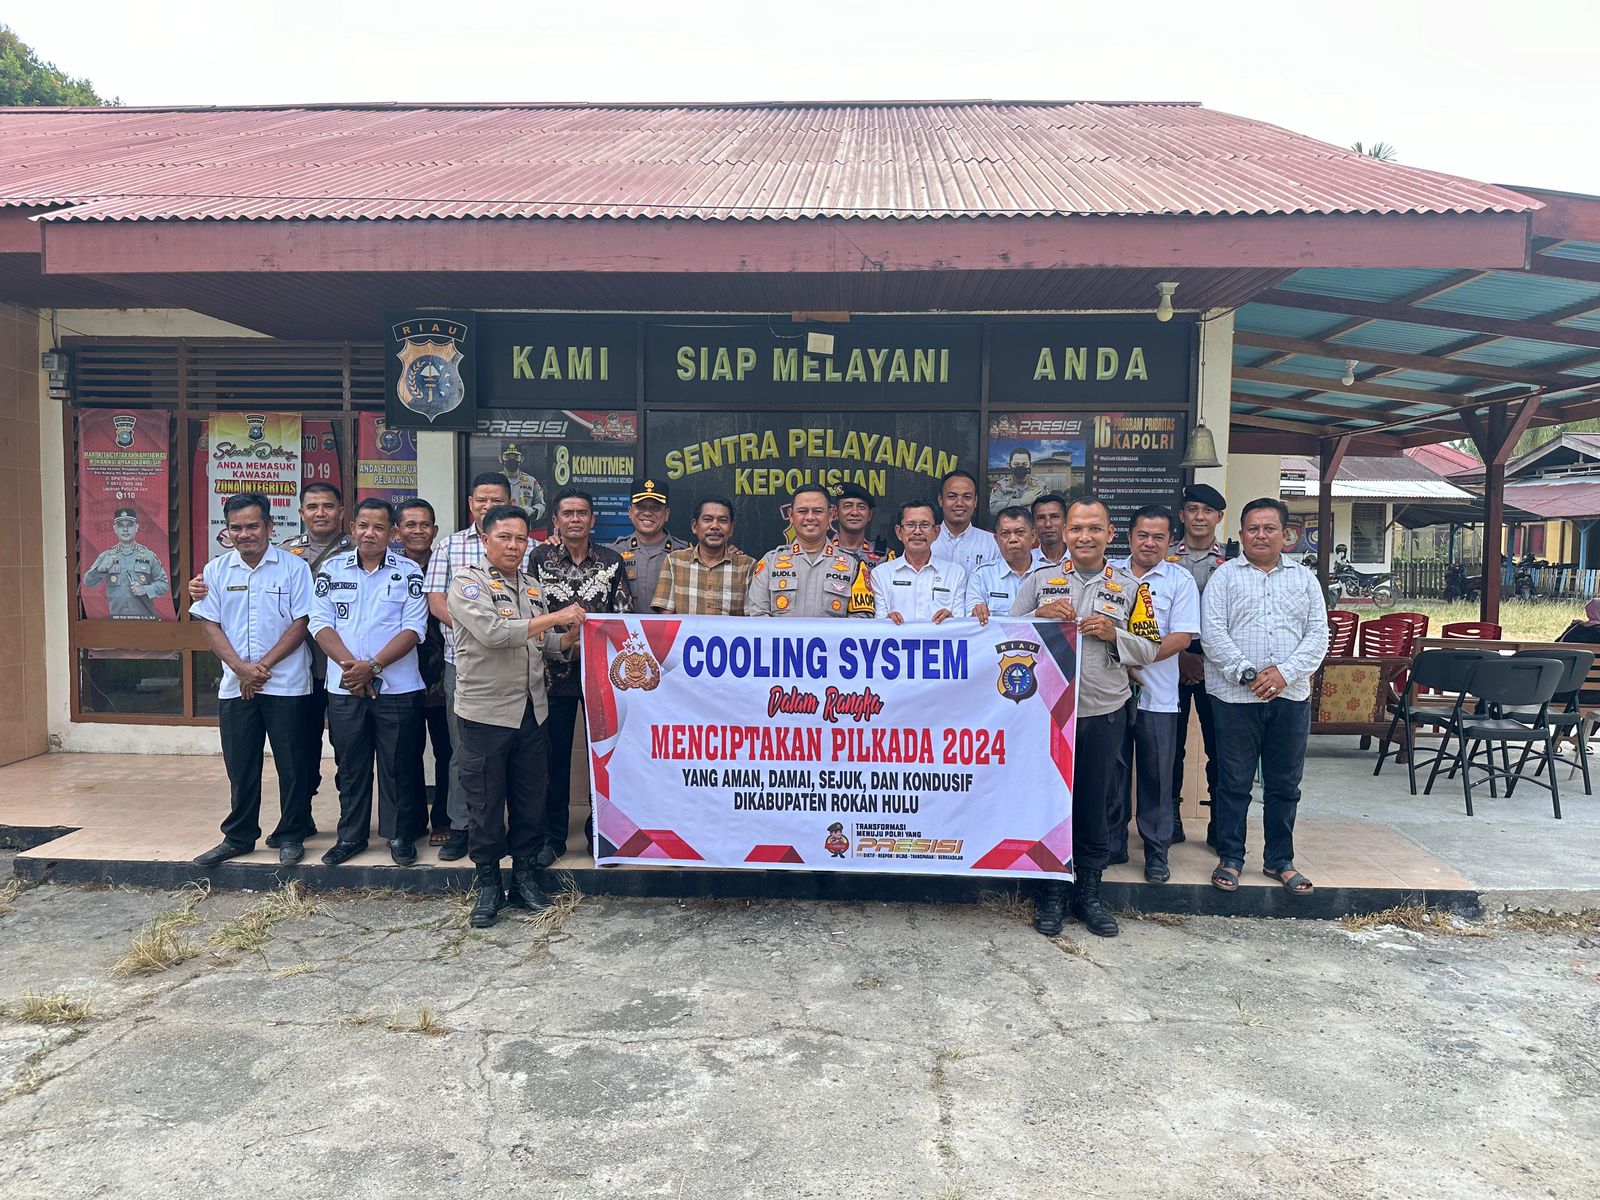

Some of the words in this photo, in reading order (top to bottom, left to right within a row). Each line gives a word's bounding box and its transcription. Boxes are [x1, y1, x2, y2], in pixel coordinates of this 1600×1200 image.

[402, 323, 457, 335] RIAU
[512, 345, 609, 380] KAMI
[676, 346, 757, 381] SIAP
[773, 347, 949, 383] MELAYANI
[1033, 347, 1148, 381] ANDA
[477, 420, 568, 433] PRESISI
[1019, 420, 1082, 431] PRESISI
[1093, 415, 1111, 448] 16
[1113, 418, 1143, 431] PROGRAM
[1144, 418, 1176, 431] PRIORITAS
[1113, 433, 1174, 449] KAPOLRI
[664, 430, 780, 481] SENTRA
[788, 428, 958, 480] PELAYANAN
[246, 462, 296, 471] MEMASUKI
[318, 463, 330, 479] 19
[360, 464, 378, 473] ANDA
[381, 464, 401, 474] TIDAK
[404, 464, 417, 474] PUA
[555, 445, 570, 486] 8
[572, 456, 634, 475] KOMITMEN
[215, 479, 241, 494] ZONA
[241, 480, 297, 496] INTEGRITAS
[374, 475, 415, 485] PELAYANAN
[272, 498, 290, 507] HULU
[826, 573, 850, 582] POLRI
[1097, 591, 1125, 605] POLRI
[1000, 642, 1036, 651] RIAU
[683, 635, 827, 679] COOLING
[839, 637, 968, 680] SYSTEM
[768, 685, 819, 718] Dalam
[823, 686, 884, 723] Rangka
[651, 724, 822, 762] MENCIPTAKAN
[831, 728, 934, 763] PILKADA
[943, 728, 1006, 765] 2024
[682, 769, 718, 787] YANG
[722, 769, 765, 791] AMAN,
[769, 770, 815, 792] DAMAI,
[819, 770, 867, 793] SEJUK,
[871, 771, 898, 790] DAN
[903, 772, 973, 792] KONDUSIF
[734, 792, 827, 811] DIKABUPATEN
[831, 793, 878, 813] ROKAN
[882, 795, 919, 813] HULU
[856, 838, 963, 854] PRESISI
